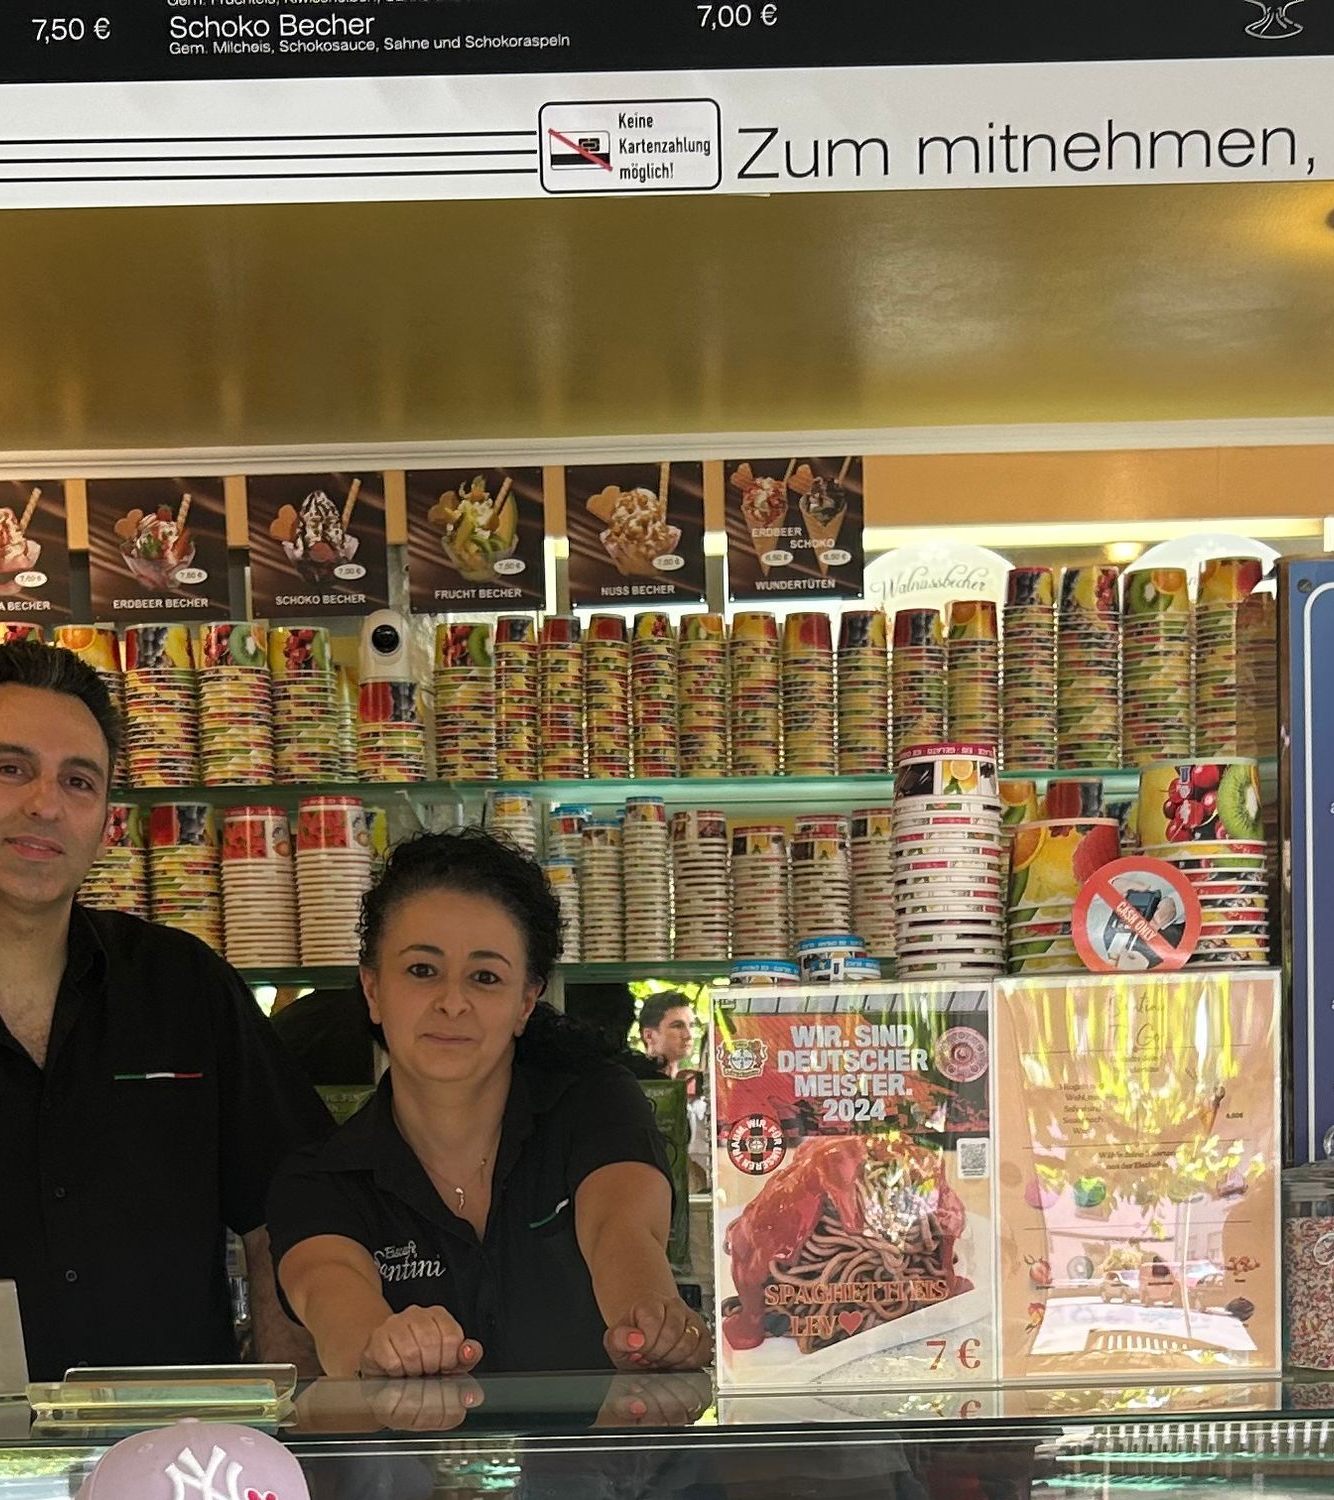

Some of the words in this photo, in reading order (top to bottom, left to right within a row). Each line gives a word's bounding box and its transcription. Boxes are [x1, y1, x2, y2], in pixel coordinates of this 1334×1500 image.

[169, 15, 270, 39] Schoko
[279, 13, 376, 36] Becher
[697, 5, 752, 29] 7,00
[760, 4, 778, 26] €
[32, 18, 84, 43] 7,50
[94, 17, 111, 39] €
[169, 42, 208, 55] Gem.
[213, 41, 275, 55] Milcheis,
[279, 39, 380, 54] Schokosauce,
[383, 38, 430, 51] Sahne
[434, 37, 461, 50] und
[465, 34, 571, 50] Schokoraspeln
[618, 112, 654, 129] Keine
[618, 136, 711, 157] Kartenzahlung
[736, 126, 890, 181] Zum
[917, 118, 1316, 174] mitnehmen,
[619, 162, 674, 184] möglich!
[751, 527, 803, 538] ERDBEER
[789, 538, 836, 549] SCHOKO
[434, 588, 477, 600] FRUCHT
[479, 587, 523, 599] BECHER
[601, 585, 629, 596] NUSS
[631, 584, 676, 596] BECHER
[755, 578, 836, 591] WUNDERTÜTEN
[7, 600, 51, 612] BECHER
[113, 598, 165, 609] ERDBEER
[166, 597, 209, 608] BECHER
[275, 595, 320, 606] SCHOKO
[322, 593, 366, 605] BECHER
[1115, 901, 1139, 929] CASH
[1133, 915, 1157, 943] ONLY
[789, 1026, 849, 1048] WIR.
[855, 1024, 914, 1048] SIND
[777, 1048, 930, 1073] DEUTSCHER
[793, 1073, 914, 1098] MEISTER.
[822, 1098, 886, 1122] 2024
[764, 1281, 906, 1306] SPAGHETTI
[909, 1279, 950, 1300] EIS
[790, 1315, 838, 1338] LEV
[925, 1339, 947, 1371] 7
[957, 1338, 981, 1369] €
